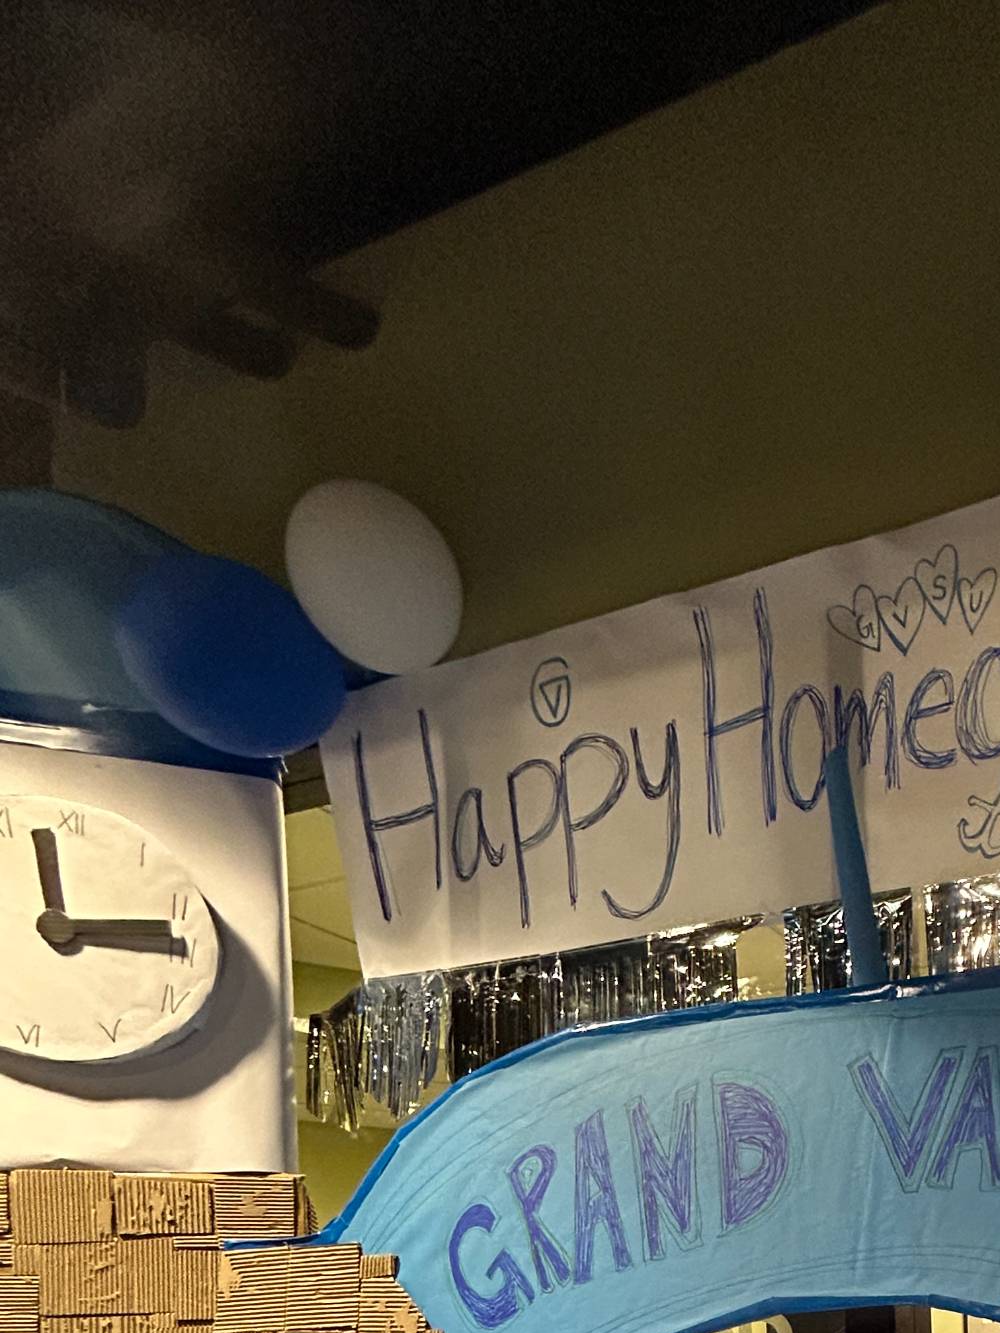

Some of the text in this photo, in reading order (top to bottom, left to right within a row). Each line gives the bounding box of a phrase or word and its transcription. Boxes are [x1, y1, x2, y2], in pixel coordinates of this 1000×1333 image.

[58, 810, 84, 837] XII
[354, 706, 682, 930] Happy
[161, 983, 192, 1014] IV
[16, 1023, 41, 1048] VI
[98, 1018, 123, 1043] V
